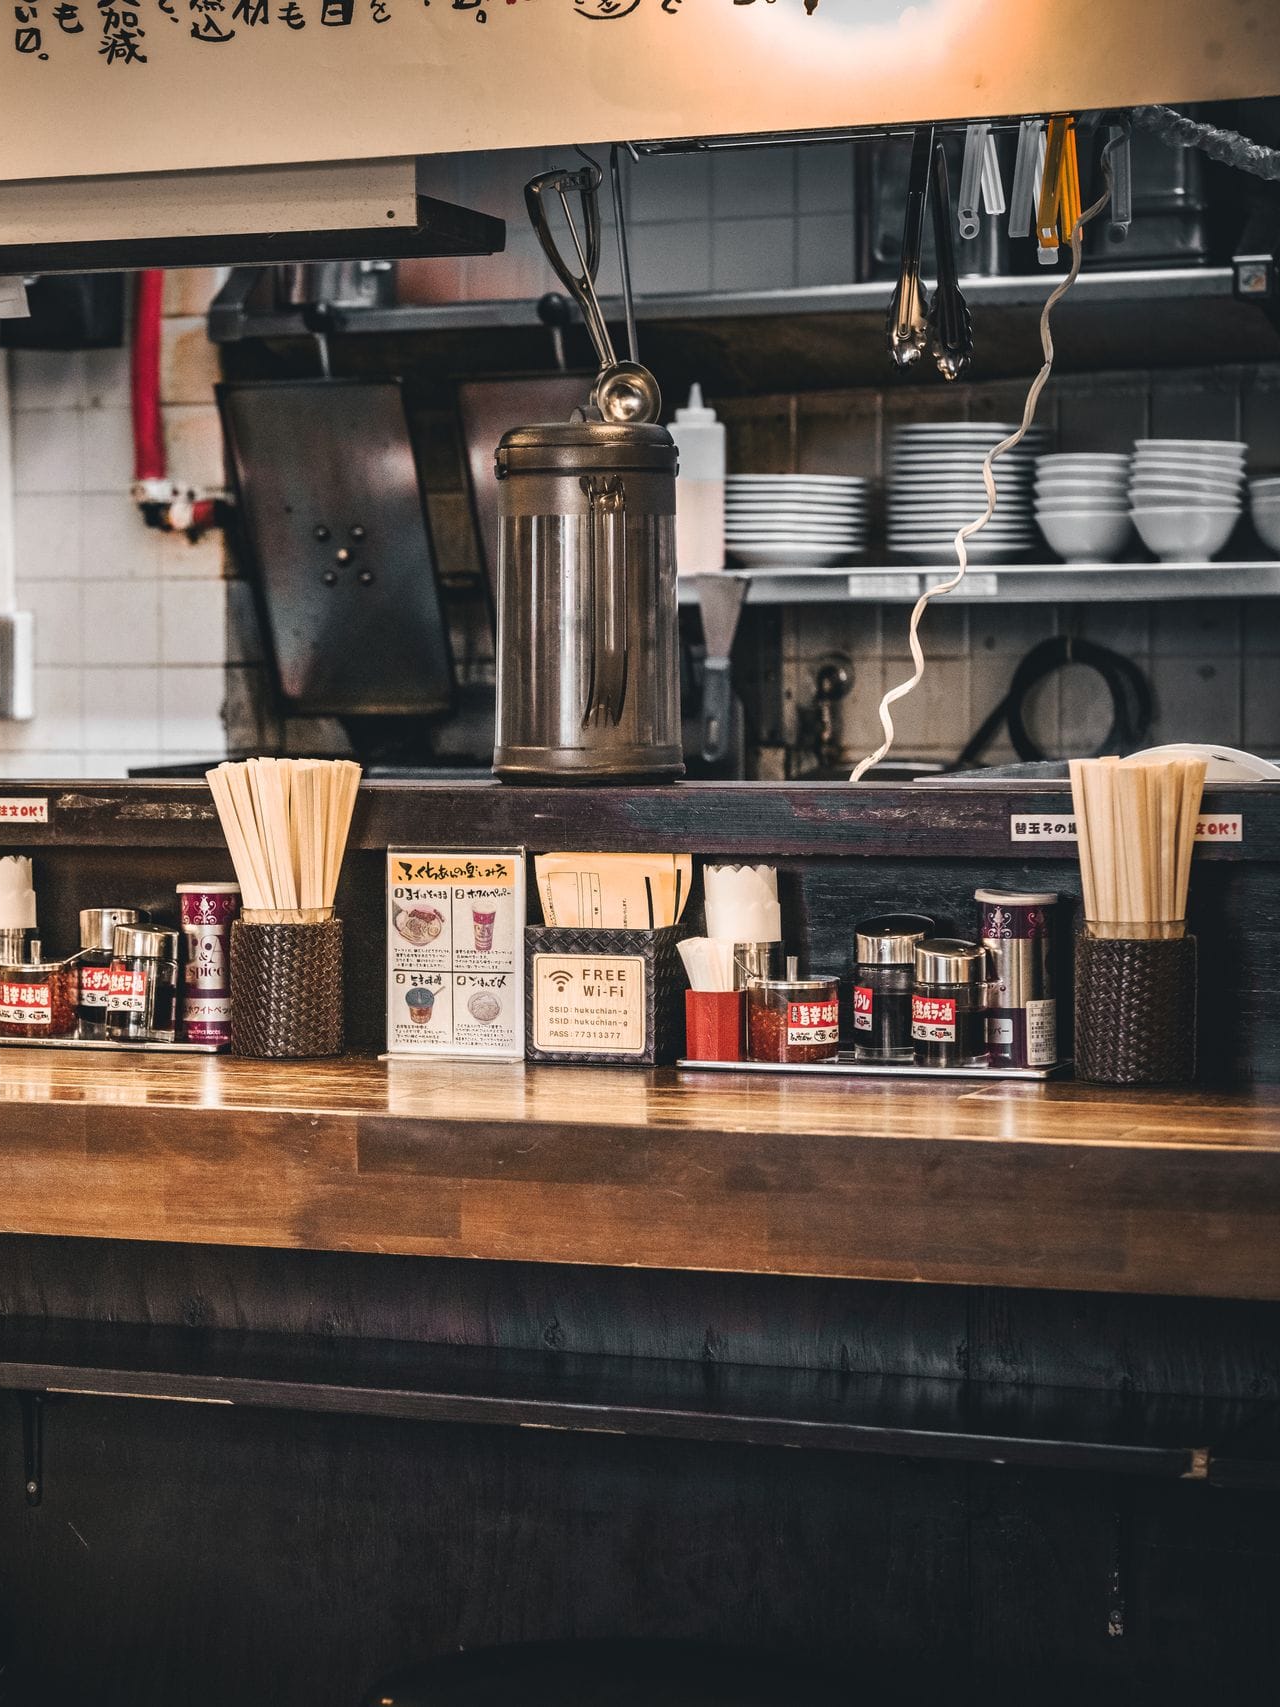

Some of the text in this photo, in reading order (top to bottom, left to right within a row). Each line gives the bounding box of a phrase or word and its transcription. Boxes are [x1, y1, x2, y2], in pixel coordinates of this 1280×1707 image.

[583, 969, 627, 981] FREE
[583, 986, 625, 998] Wi-Fi
[575, 1030, 621, 1039] 77313377
